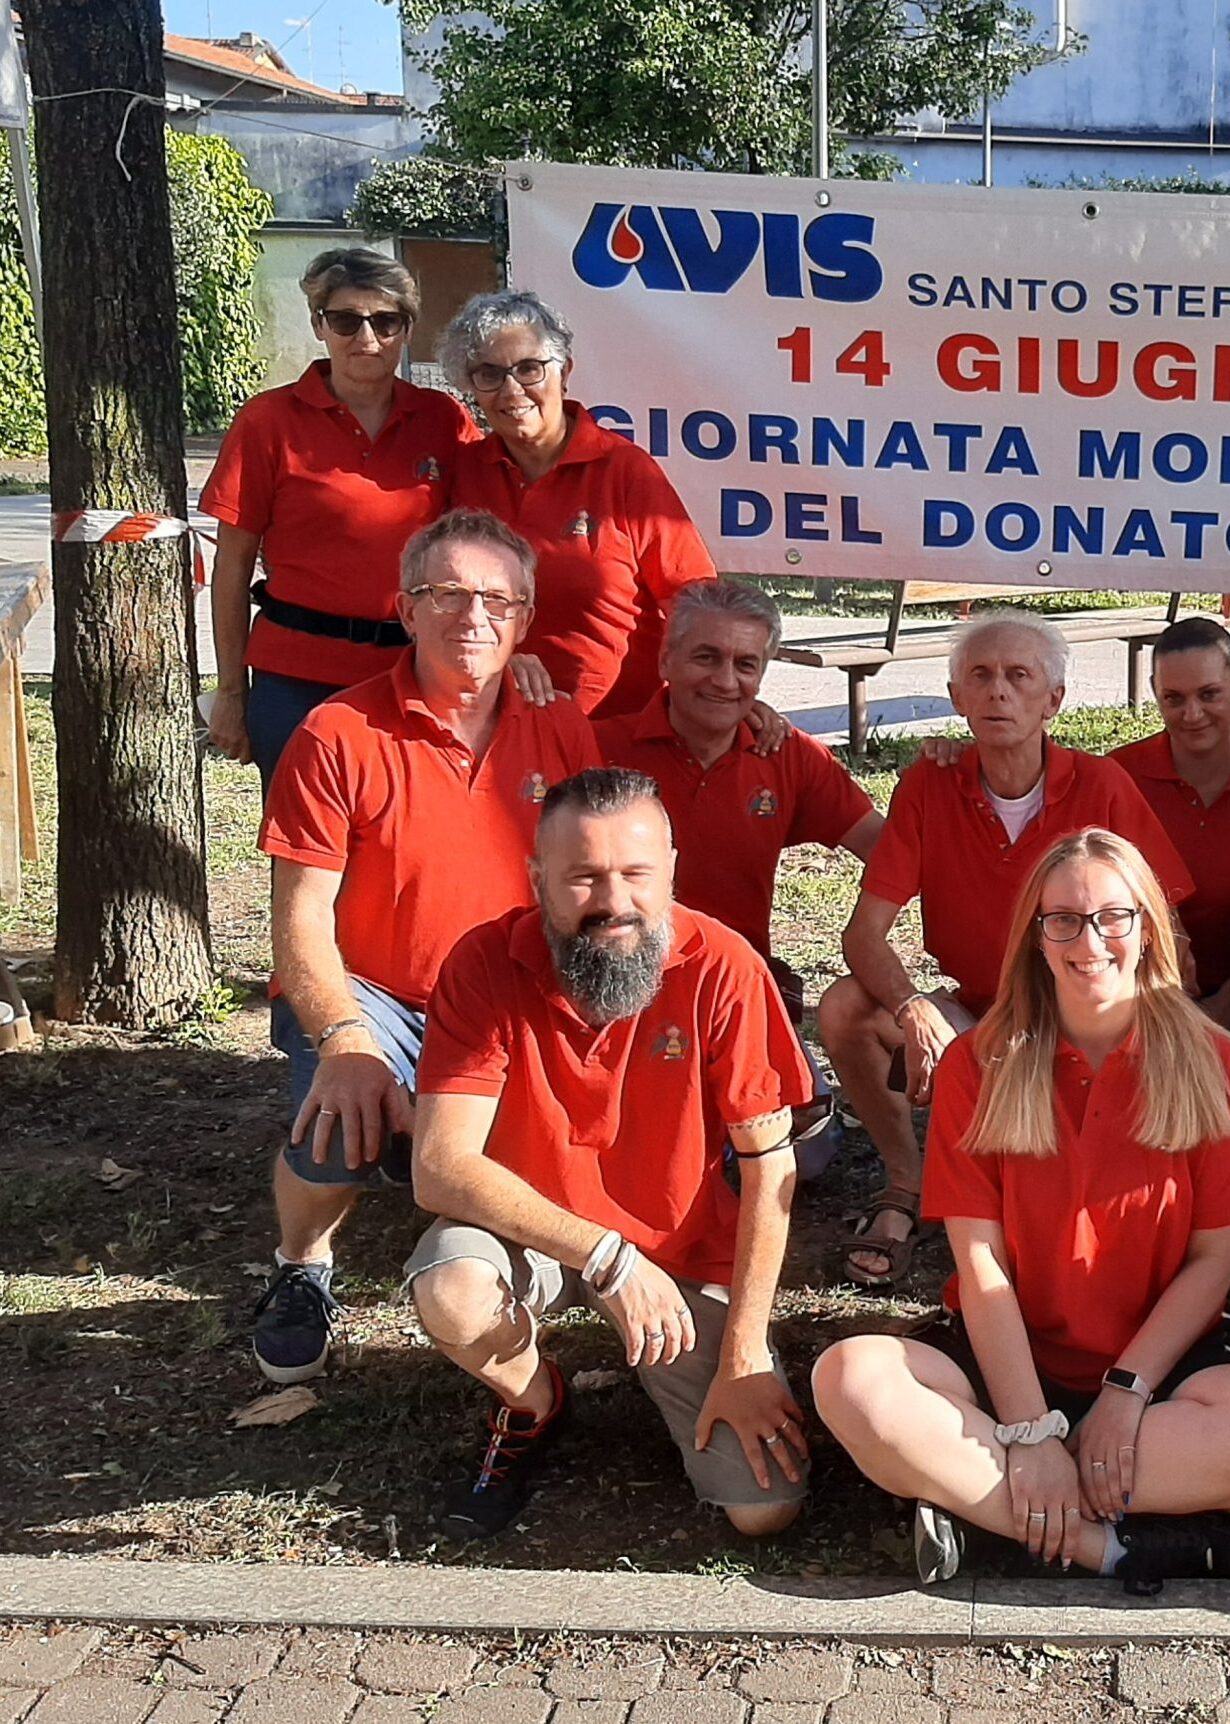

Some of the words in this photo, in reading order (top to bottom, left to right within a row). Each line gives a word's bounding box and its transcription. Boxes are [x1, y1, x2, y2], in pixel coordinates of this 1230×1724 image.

[572, 203, 883, 303] AVIS
[909, 273, 1085, 313] SANTO
[778, 327, 891, 387] 14
[720, 488, 882, 544] DEL
